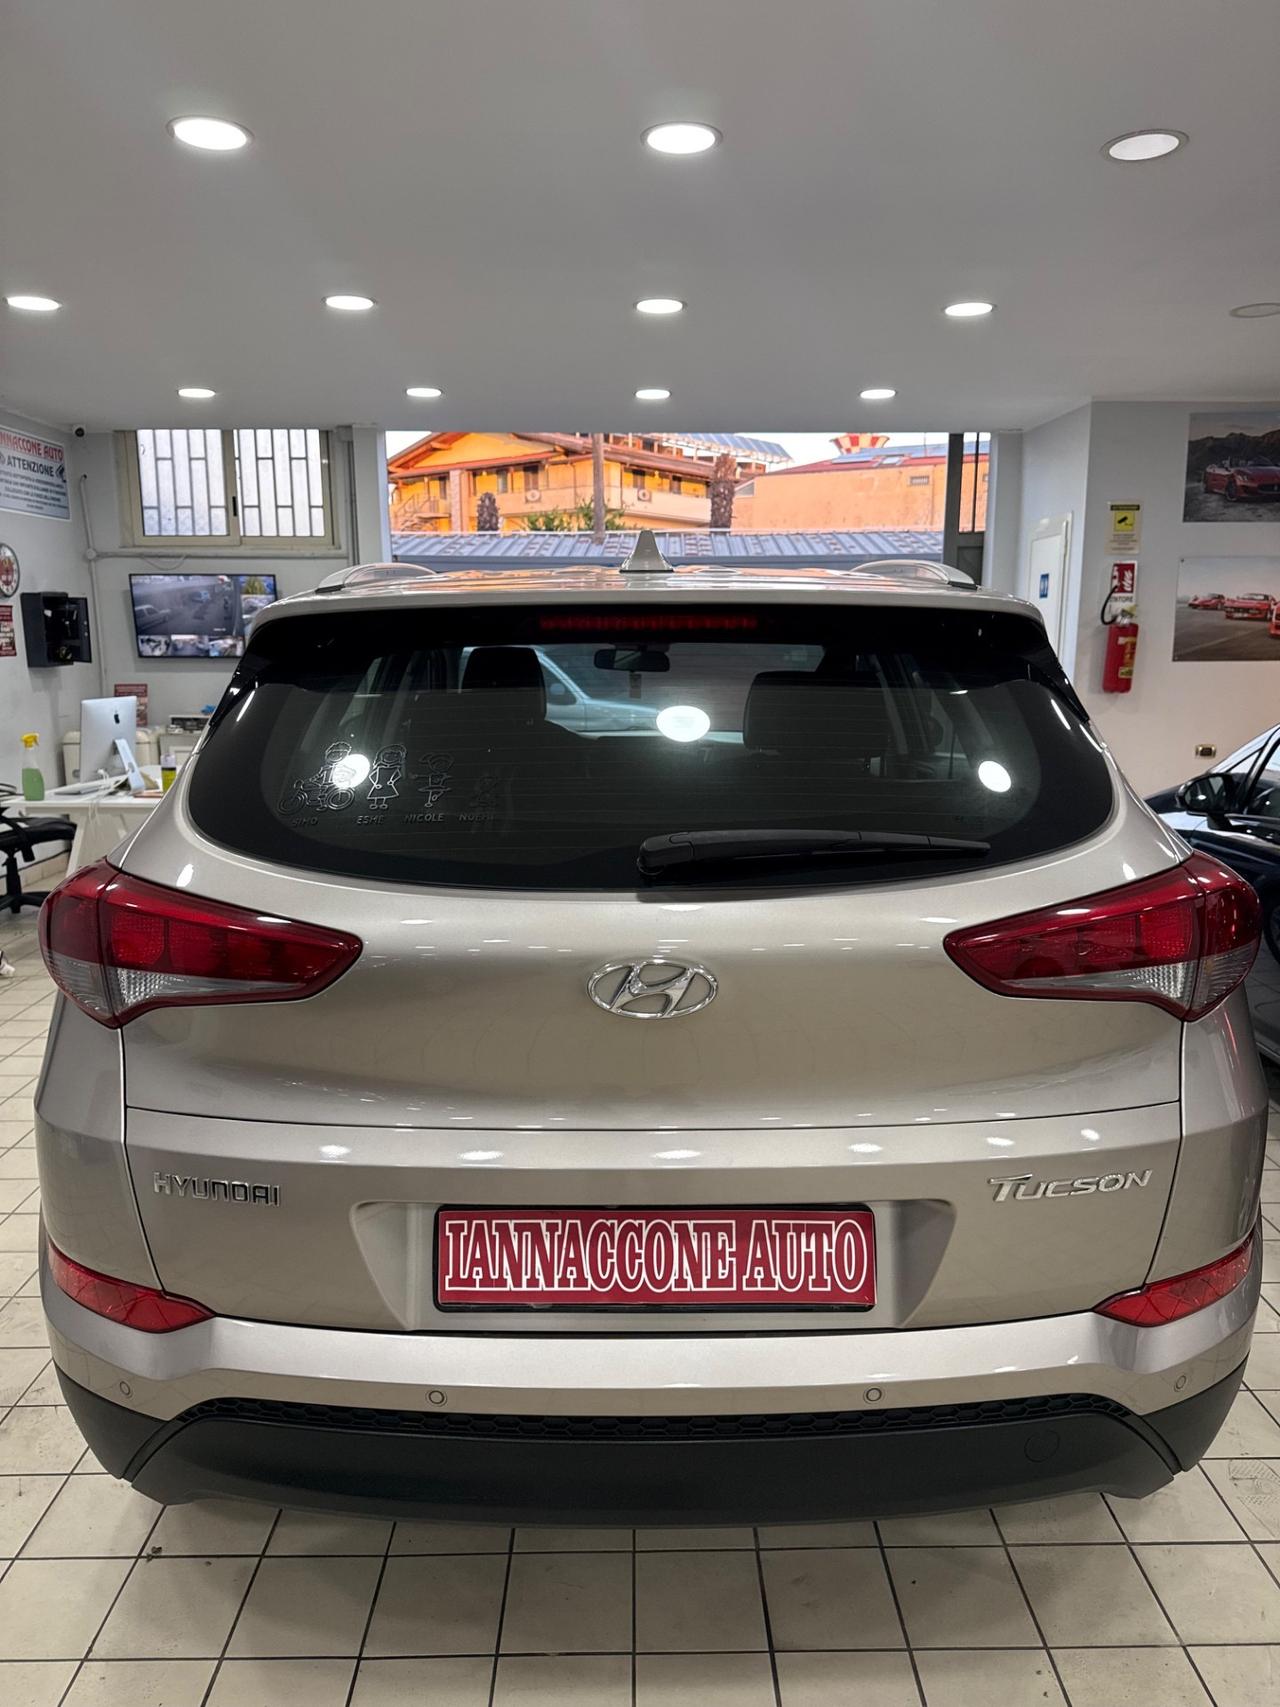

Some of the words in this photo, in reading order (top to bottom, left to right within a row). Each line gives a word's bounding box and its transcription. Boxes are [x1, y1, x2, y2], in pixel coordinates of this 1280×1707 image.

[43, 444, 64, 462] AUTO
[7, 455, 54, 477] ATTENZIONE
[404, 812, 446, 822] NICOLE
[153, 1171, 280, 1206] HYUNDAI
[445, 1219, 737, 1291] IANNACCONE
[743, 1219, 868, 1292] AUTO
